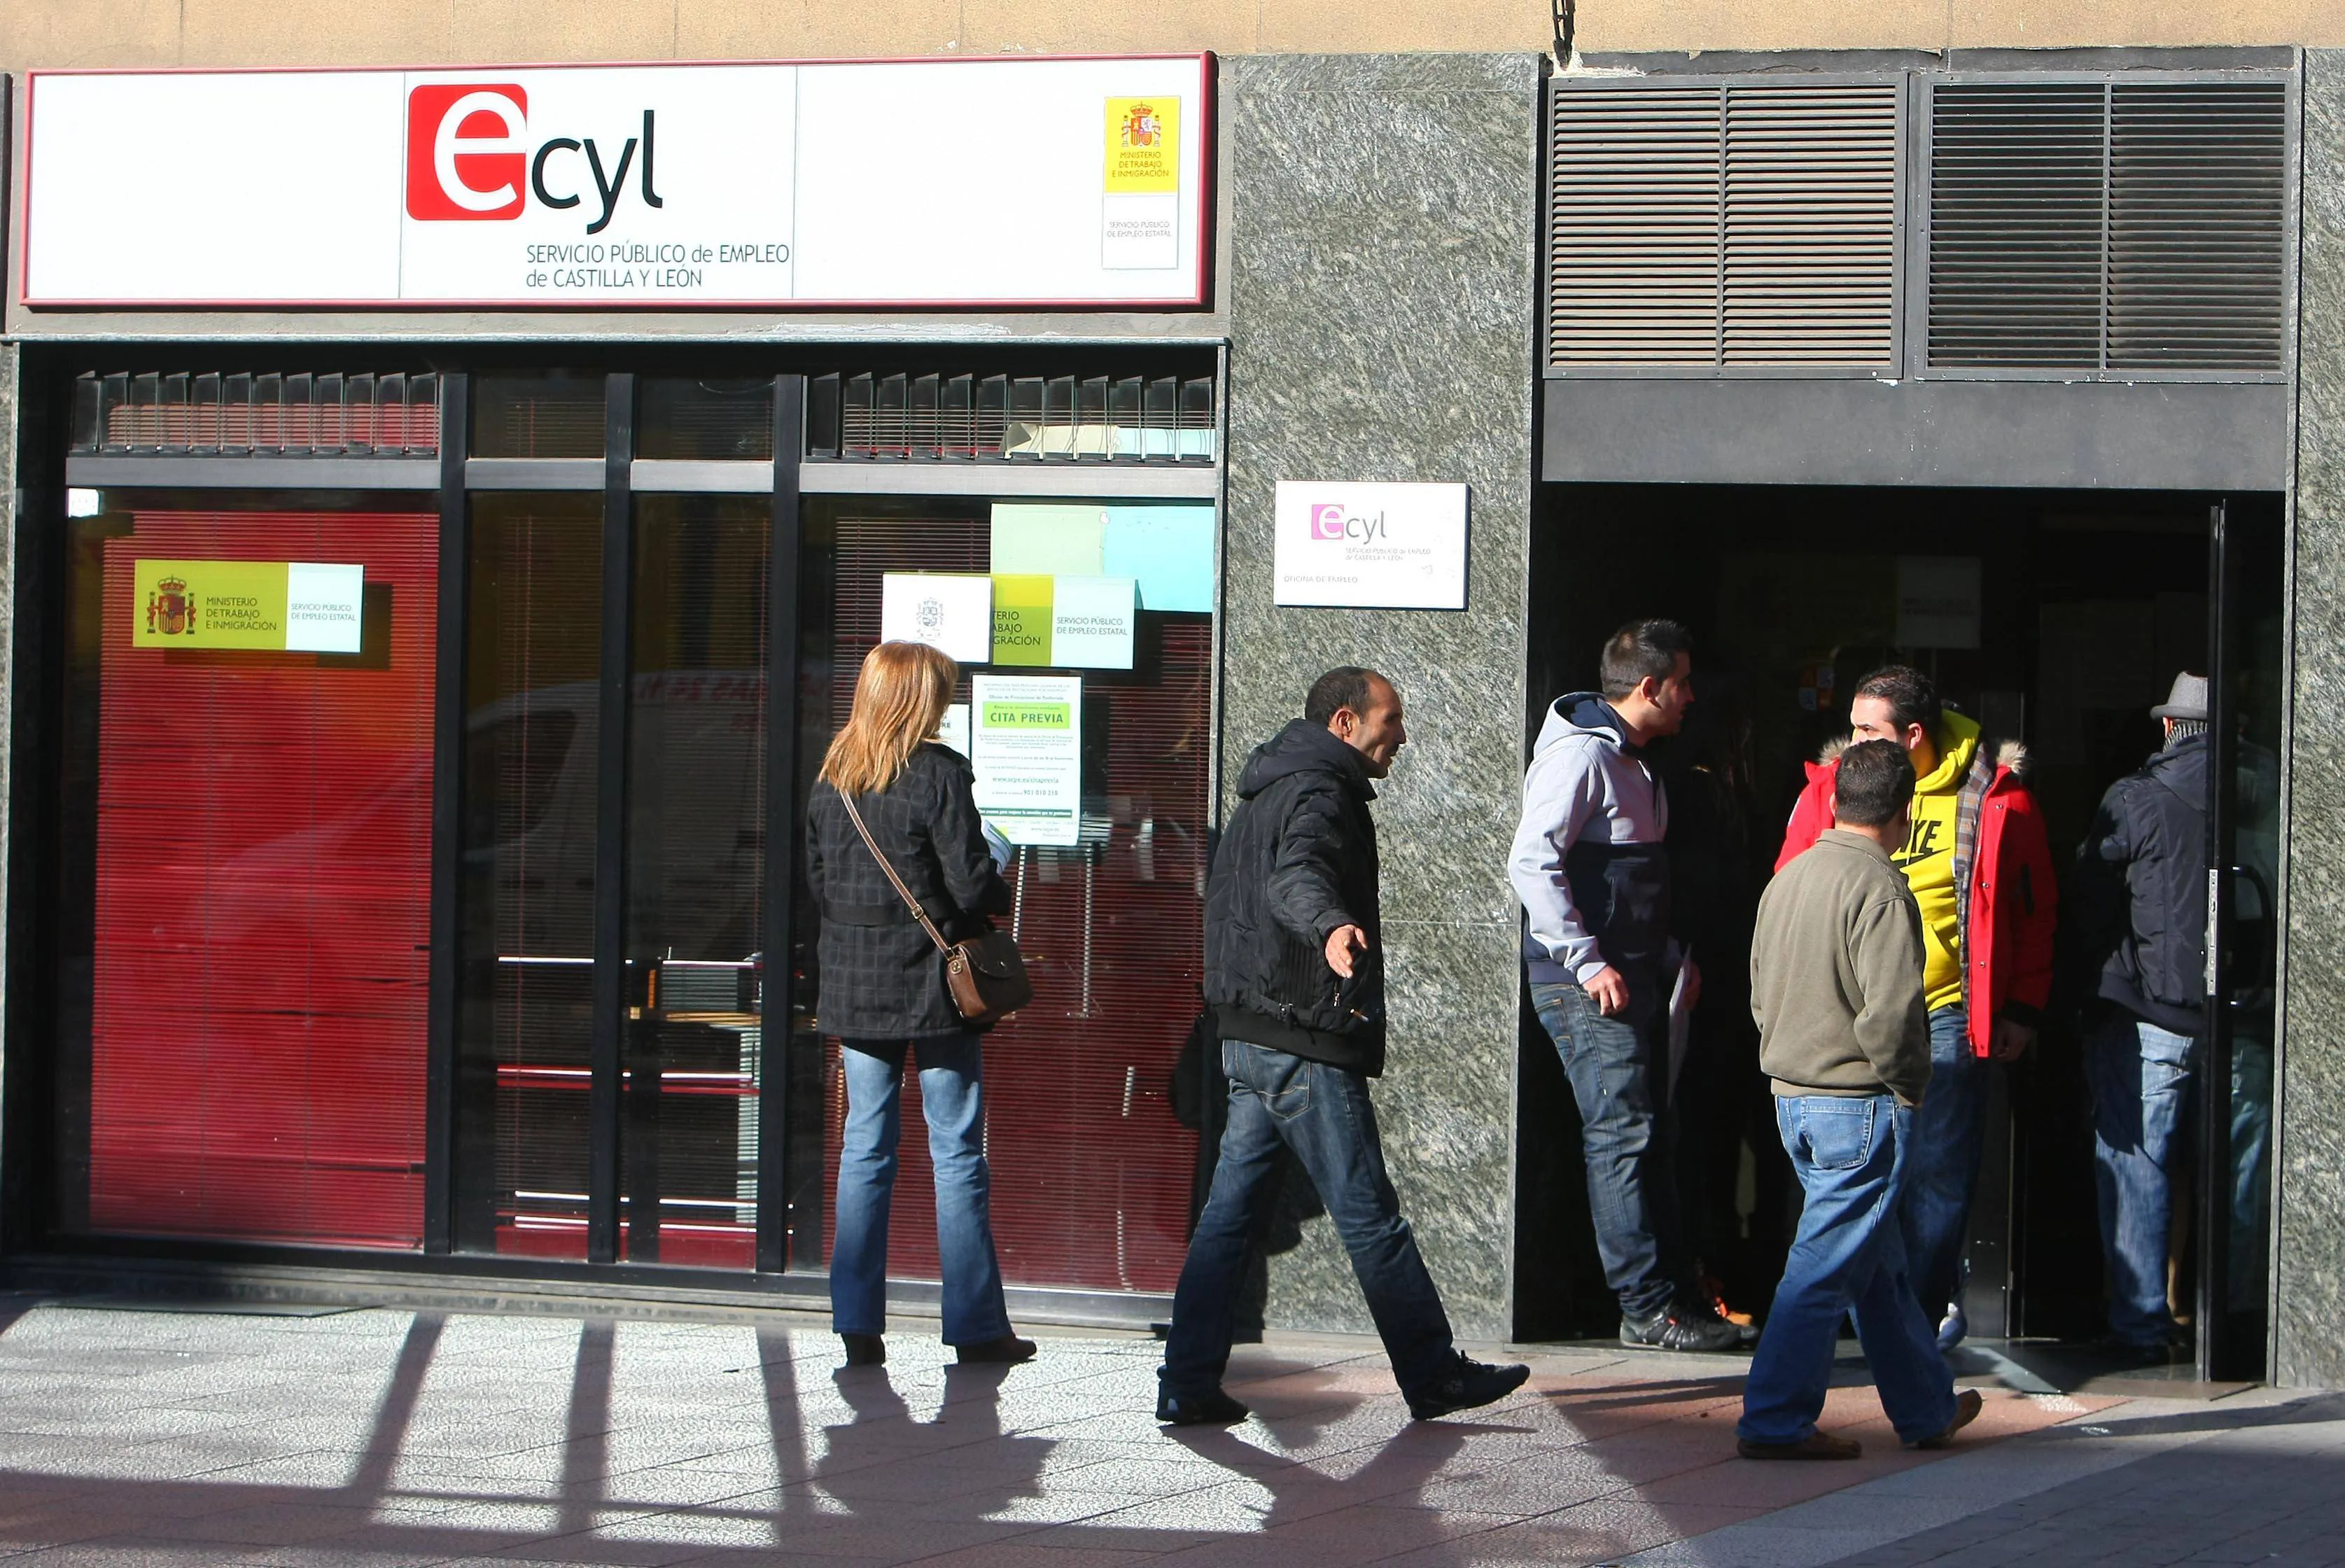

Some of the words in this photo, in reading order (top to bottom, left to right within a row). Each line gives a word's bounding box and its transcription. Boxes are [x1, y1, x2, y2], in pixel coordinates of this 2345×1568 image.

[433, 90, 663, 234] ecyl
[1129, 161, 1162, 169] TRABAJO
[1118, 169, 1169, 178] INMIGRACIÓN
[526, 245, 604, 263] SERVICIO
[610, 239, 685, 263] PÚBLICO
[691, 244, 713, 263] de
[720, 244, 790, 263] EMPLEO
[526, 269, 548, 288] de
[553, 269, 634, 288] CASTILLA
[639, 269, 648, 288] Y
[652, 263, 702, 288] LEÓN
[206, 597, 258, 607] MINISTERIO
[291, 603, 321, 611] SERVICIO
[206, 608, 218, 617] DE
[219, 608, 260, 620] TRABAJO
[206, 621, 211, 629] E
[213, 620, 277, 630] INMIGRACIÓN
[1091, 616, 1123, 626] PÚBLICO
[1099, 627, 1128, 636] ESTATAL
[990, 713, 1016, 722] CITA
[1021, 713, 1063, 723] PREVIA
